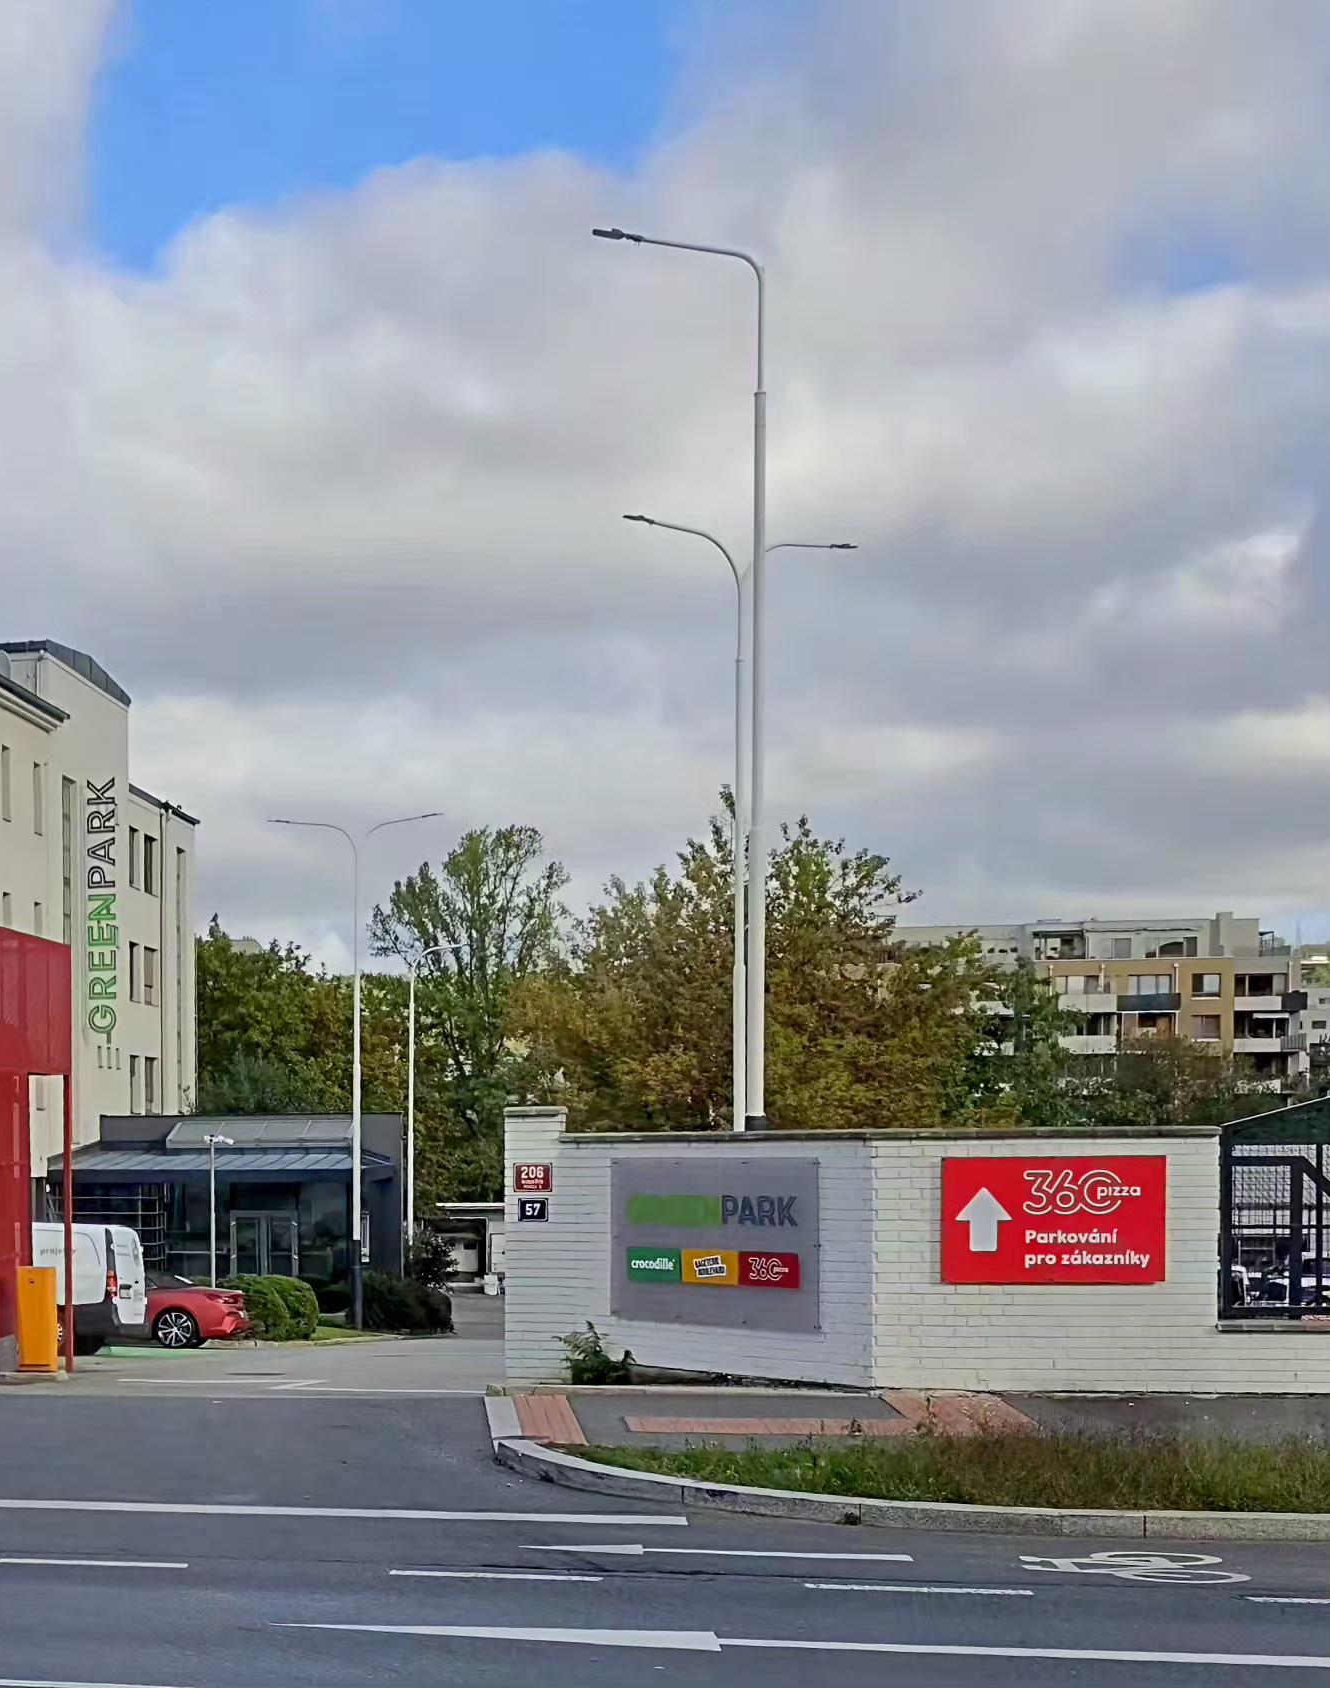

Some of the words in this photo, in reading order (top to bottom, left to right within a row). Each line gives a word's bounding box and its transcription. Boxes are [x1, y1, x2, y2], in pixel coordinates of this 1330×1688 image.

[521, 1166, 544, 1178] 206
[1023, 1169, 1122, 1215] 360
[1097, 1186, 1141, 1200] pizza
[525, 1203, 540, 1216] 57
[1025, 1228, 1118, 1244] Parkování
[1025, 1253, 1057, 1268] pro
[1061, 1250, 1150, 1268] zákazníky
